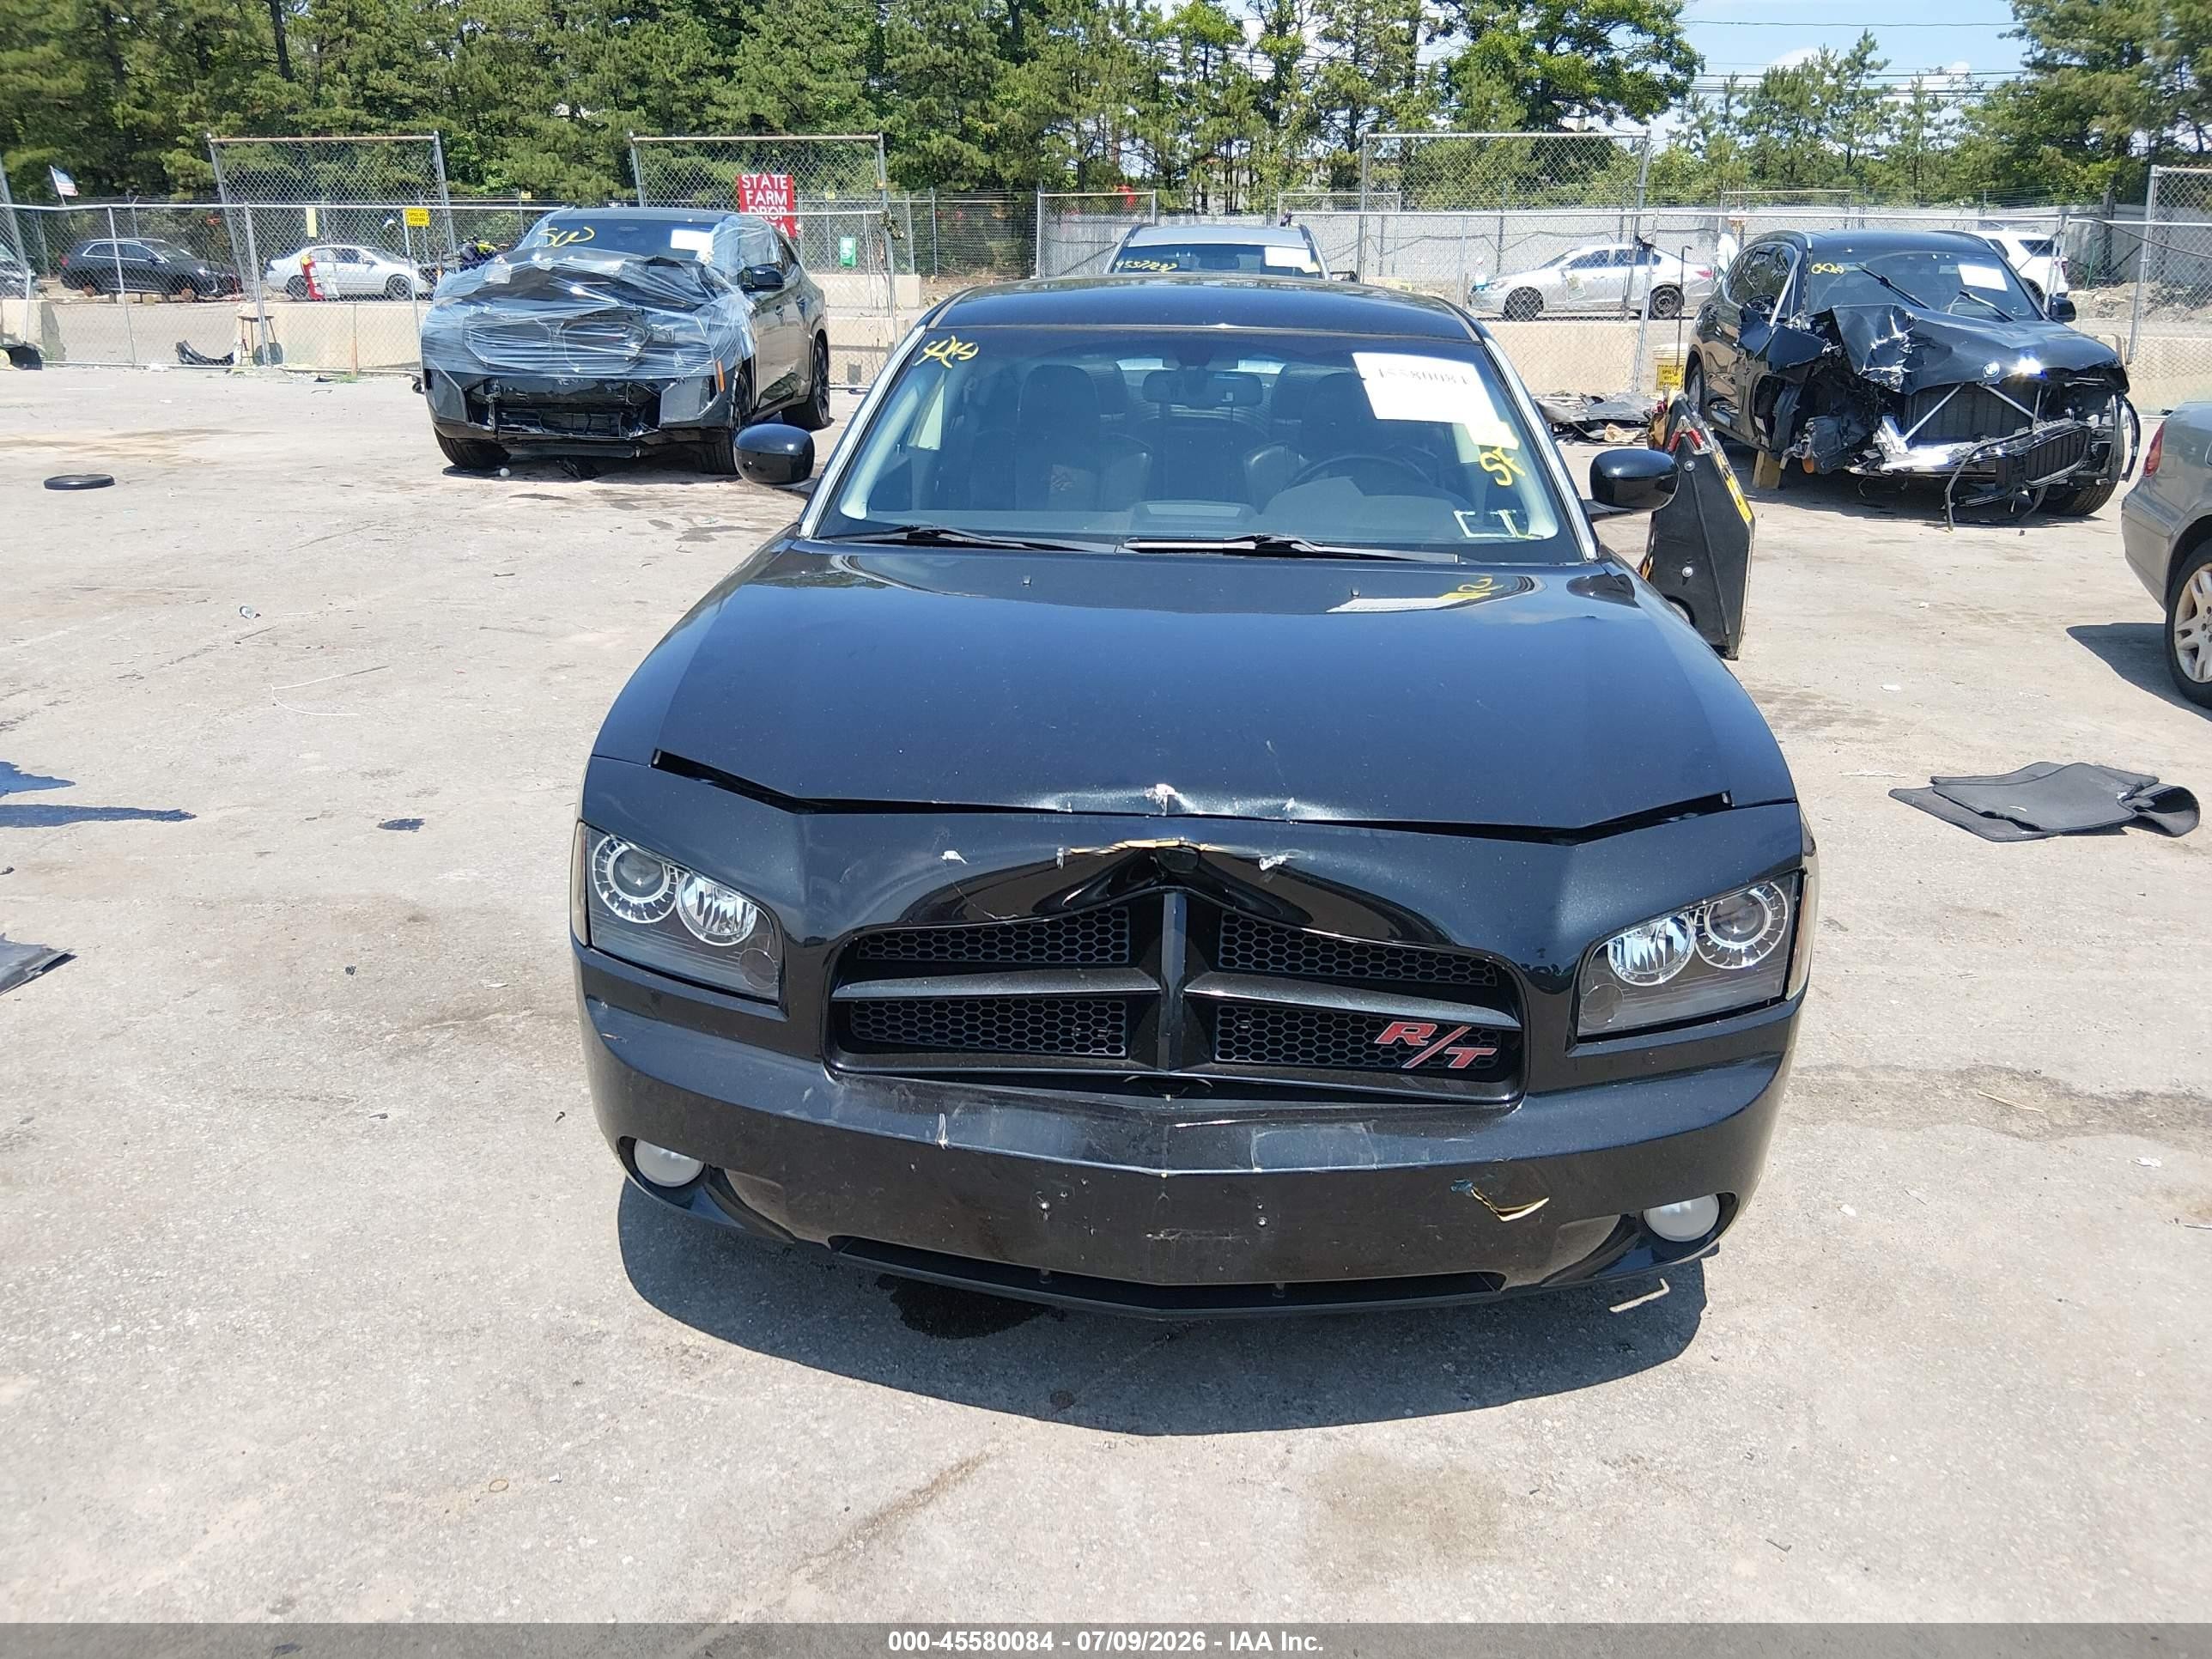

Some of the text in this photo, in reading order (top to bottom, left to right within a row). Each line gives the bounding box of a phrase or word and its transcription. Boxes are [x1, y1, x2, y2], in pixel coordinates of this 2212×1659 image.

[741, 173, 789, 190] STATE
[745, 190, 787, 205] FARM
[1374, 1021, 1498, 1069] R/T
